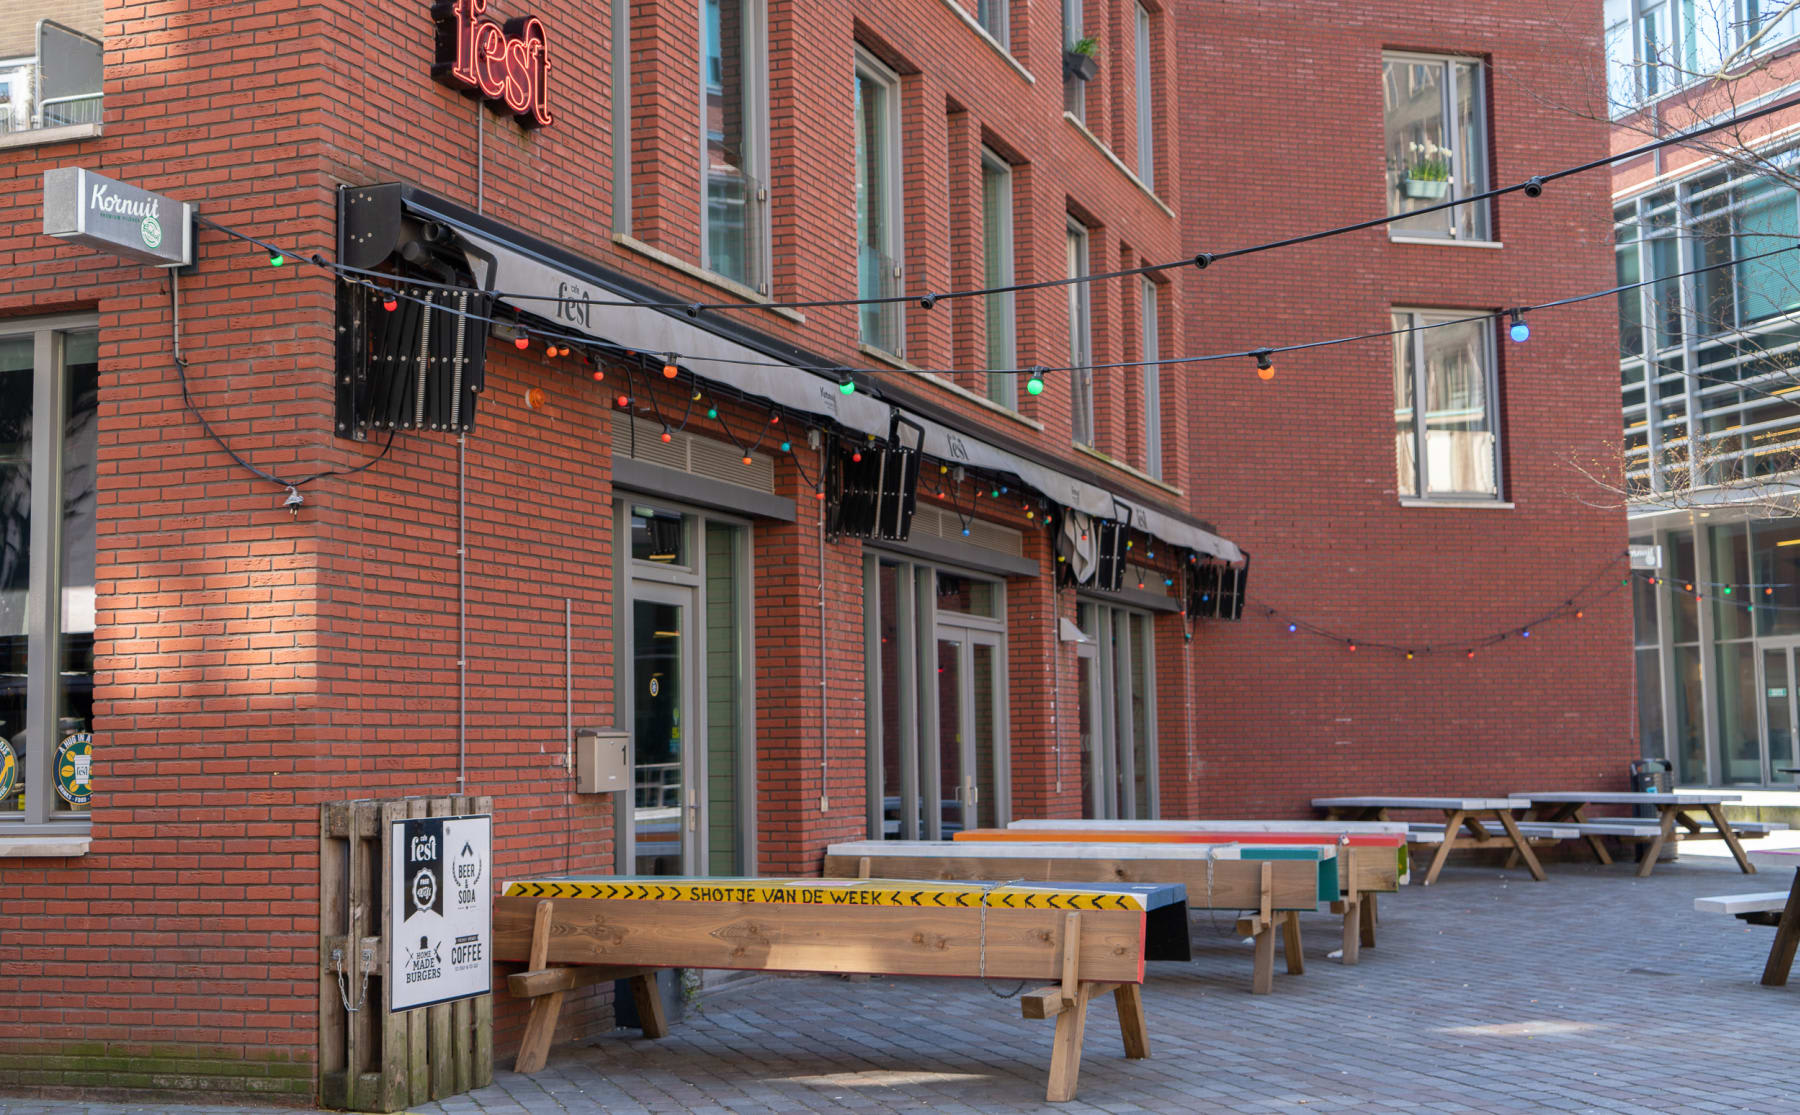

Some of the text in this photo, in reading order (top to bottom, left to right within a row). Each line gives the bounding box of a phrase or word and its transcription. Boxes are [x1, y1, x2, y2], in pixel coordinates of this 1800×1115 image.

[454, 0, 552, 125] fest
[90, 183, 160, 219] Kornuit
[556, 281, 591, 329] fest
[621, 744, 627, 766] 1
[410, 835, 437, 861] fest
[458, 864, 475, 879] BEER
[458, 889, 476, 905] SODA
[690, 887, 882, 906] SHOTJE VAN DE WEEK
[413, 957, 435, 971] MADE
[416, 950, 432, 960] HOME
[451, 943, 482, 965] COFFEE
[406, 967, 441, 984] BURGERS
